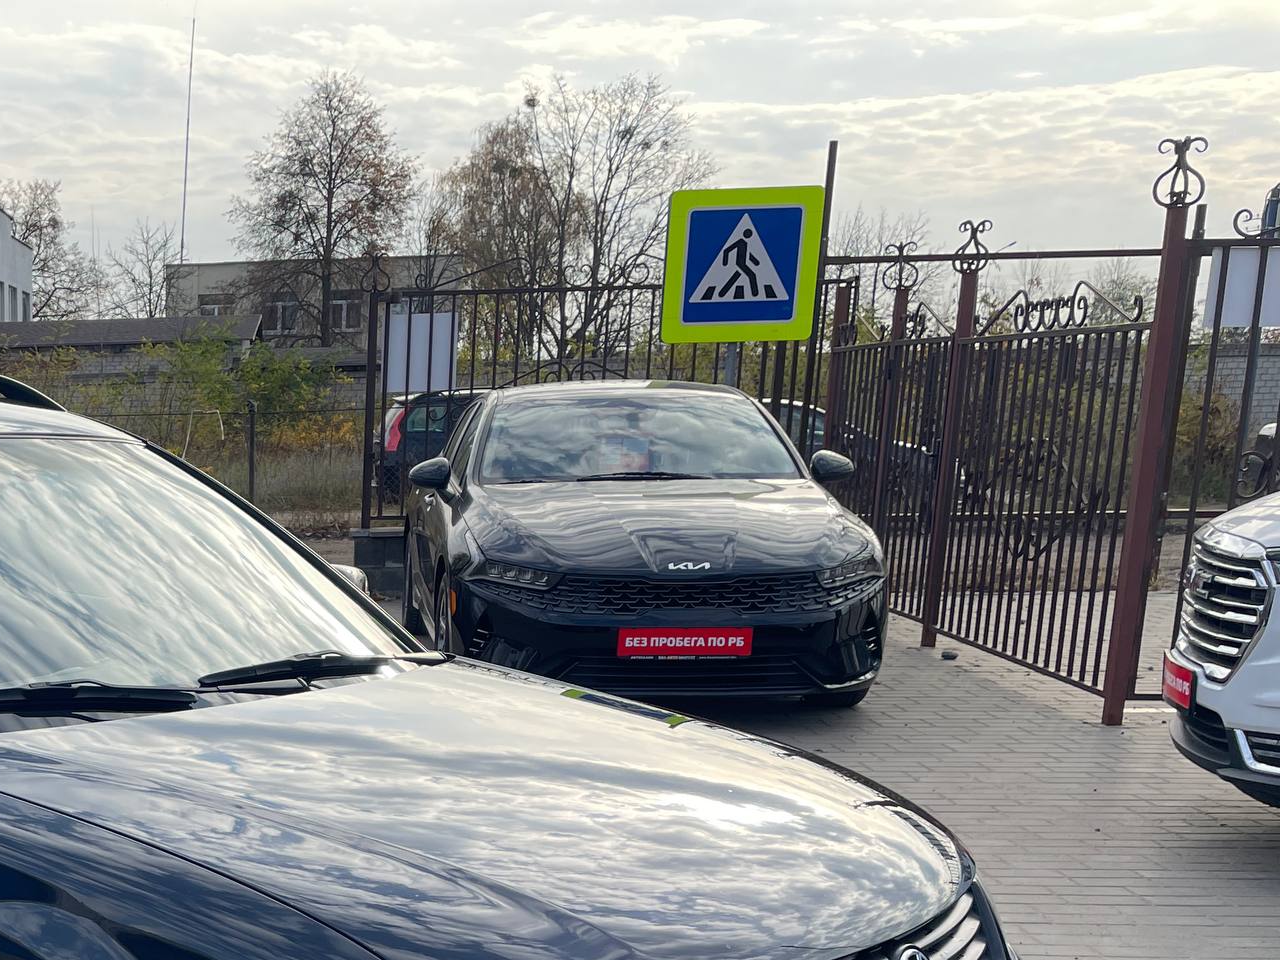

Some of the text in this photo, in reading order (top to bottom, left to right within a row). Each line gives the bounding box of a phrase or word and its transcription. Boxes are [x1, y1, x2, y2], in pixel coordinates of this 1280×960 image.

[625, 637, 745, 648] БЕЗ ПРОБЕГА ПО РБ
